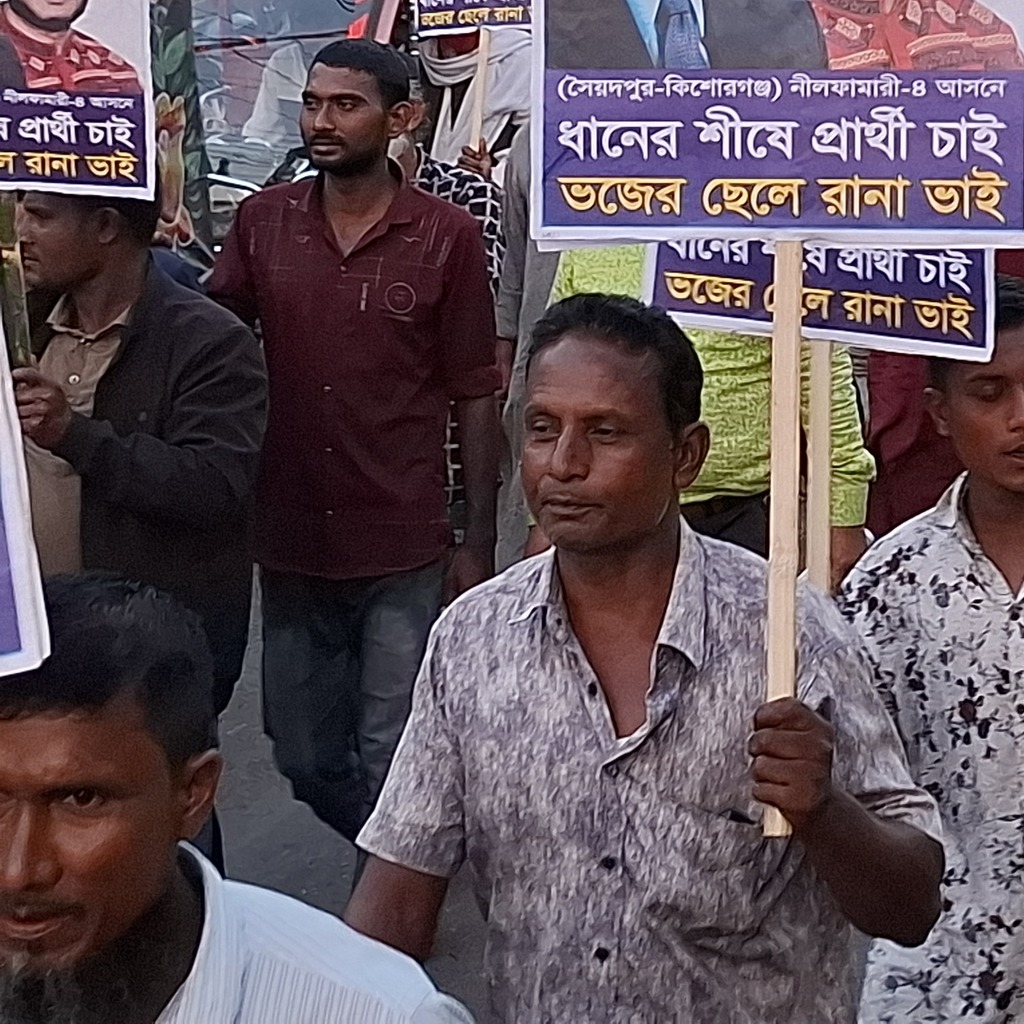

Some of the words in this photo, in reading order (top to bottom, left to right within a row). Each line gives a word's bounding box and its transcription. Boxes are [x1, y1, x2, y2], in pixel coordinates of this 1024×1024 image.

[788, 73, 927, 99] নীলফামারী-৪
[935, 77, 1007, 98] আসনে
[18, 110, 81, 144] প্রার্থী
[83, 114, 137, 149] চাই
[557, 116, 684, 161] ধানের
[693, 105, 800, 160] শীষে
[811, 106, 916, 162] প্রার্থী
[925, 108, 1007, 165] চাই
[22, 150, 80, 178] রানা
[84, 149, 140, 183] ভাই
[556, 174, 687, 216] ভজের
[702, 176, 806, 222] ছেলে
[818, 174, 911, 219] রানা
[922, 166, 1008, 224] ভাই
[914, 250, 974, 295] চাই
[663, 271, 756, 310] ভজের
[840, 289, 907, 328] রানা
[911, 291, 976, 341] ভাই
